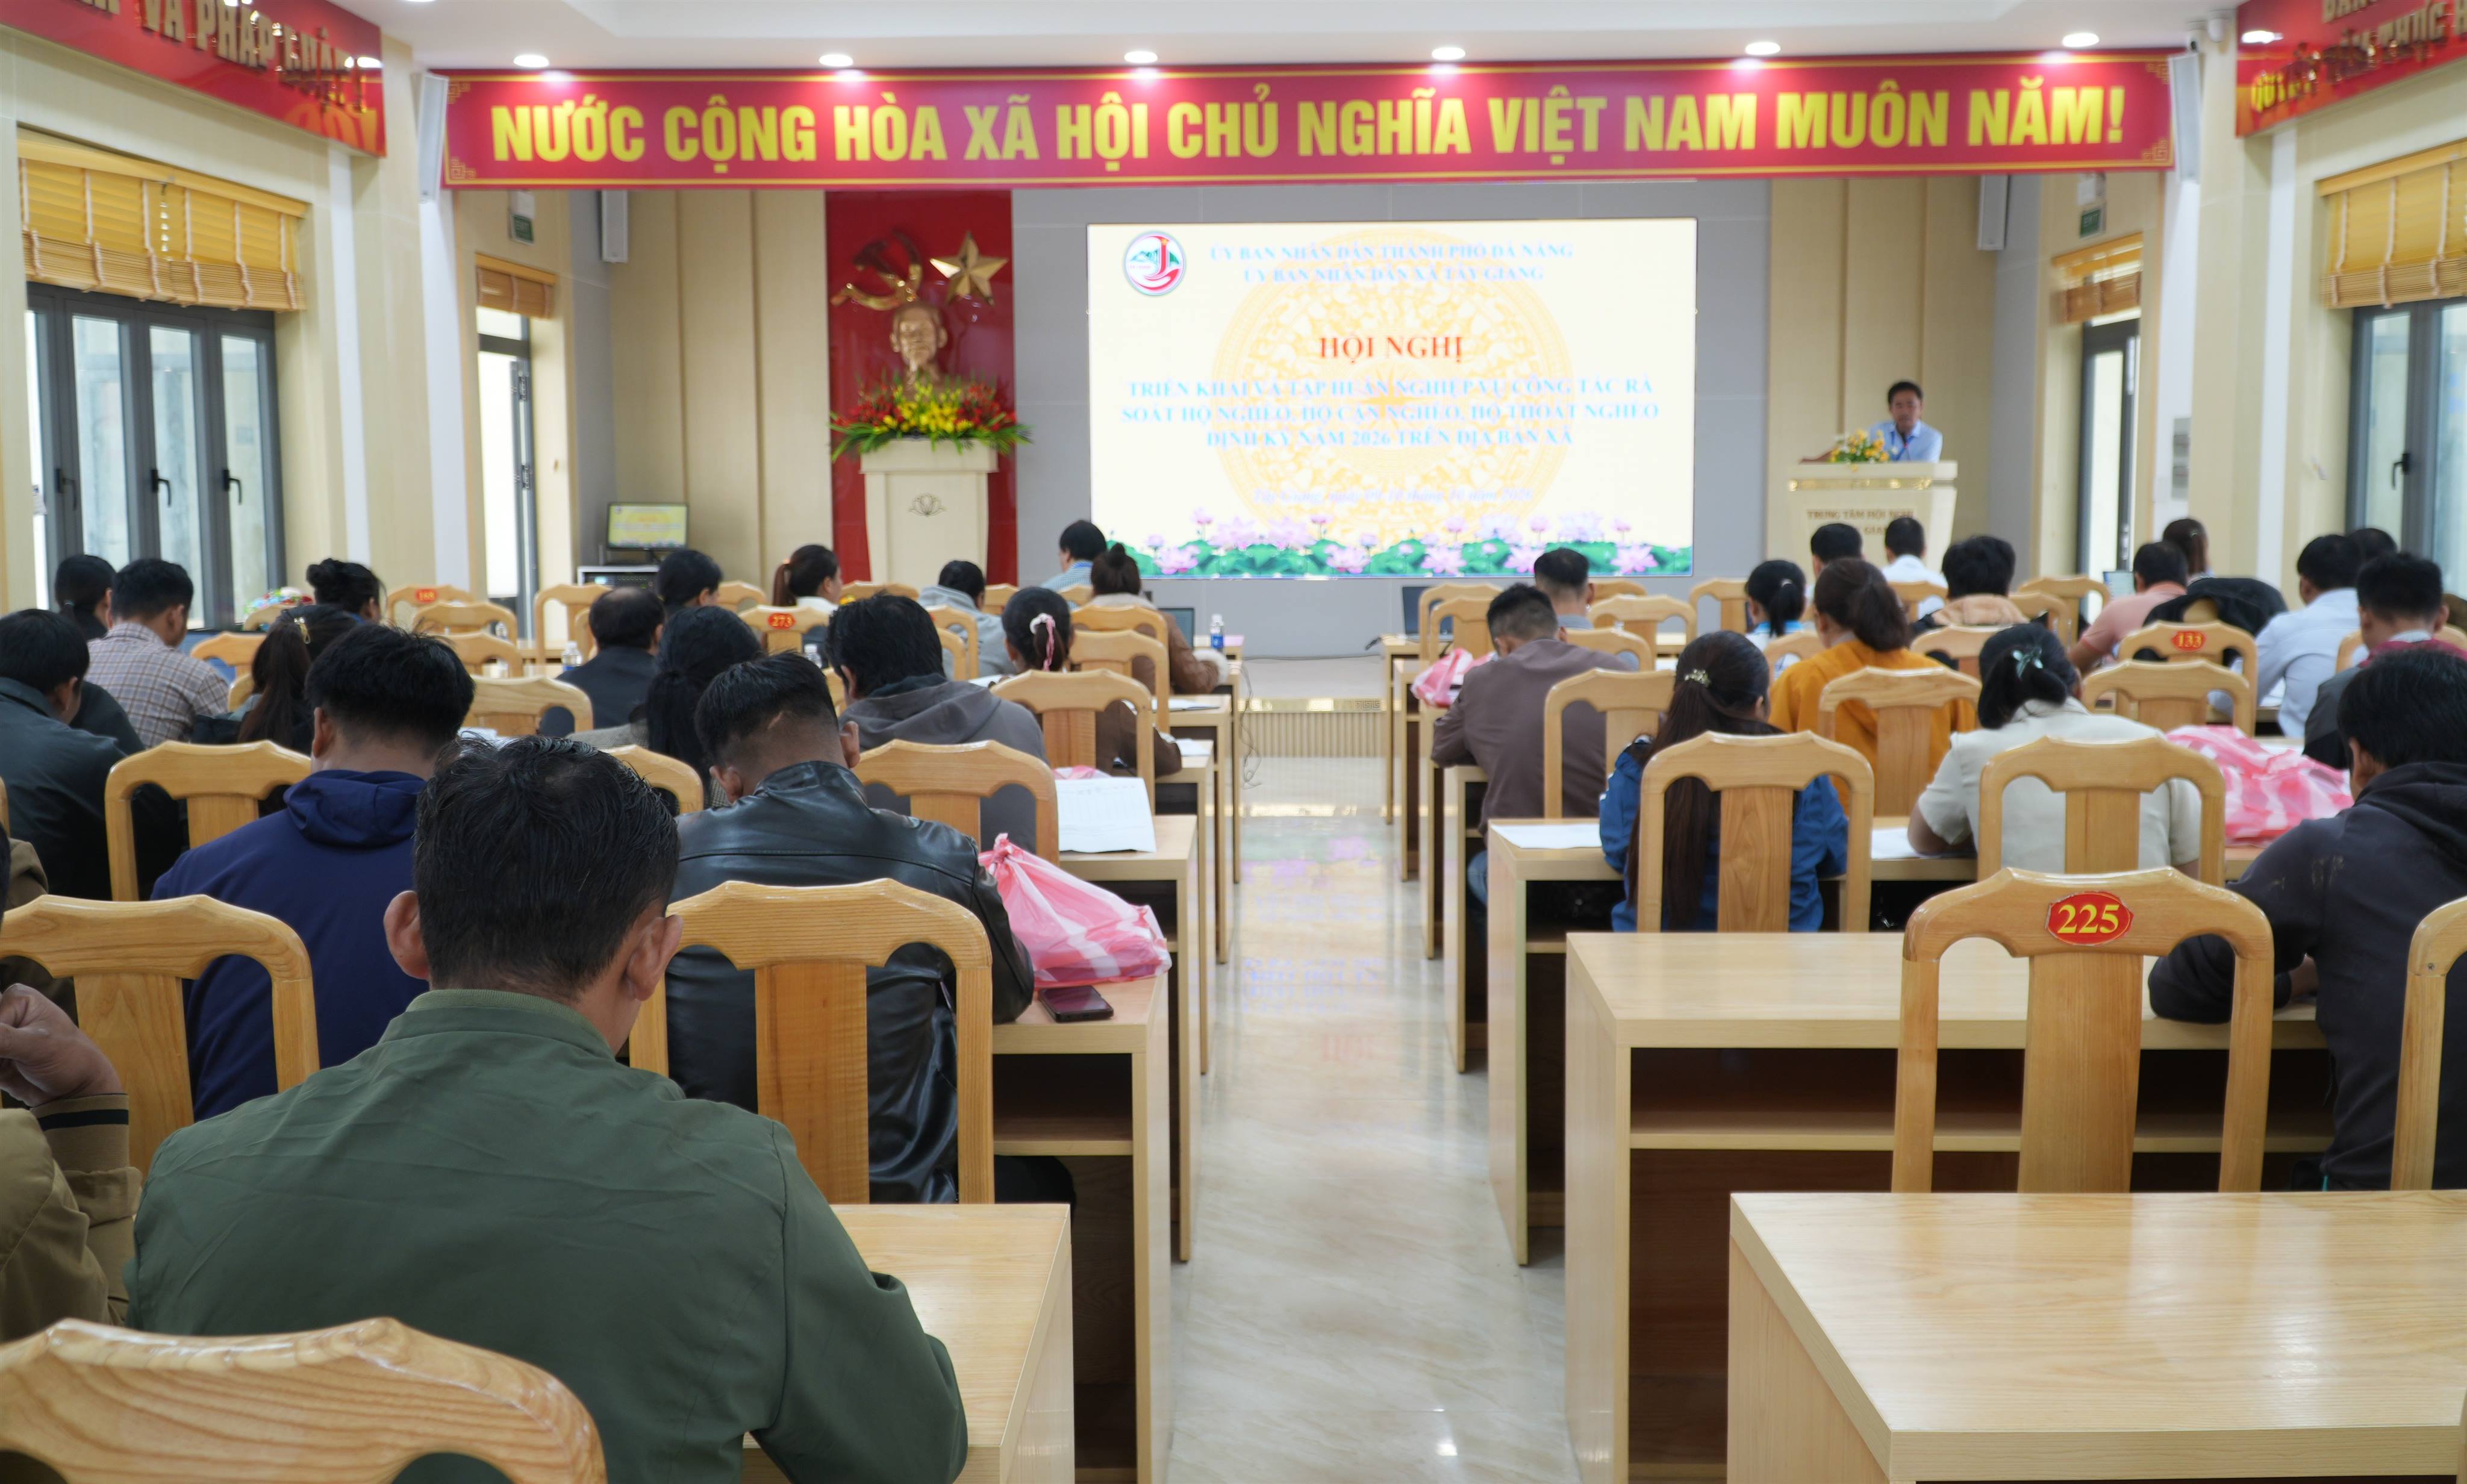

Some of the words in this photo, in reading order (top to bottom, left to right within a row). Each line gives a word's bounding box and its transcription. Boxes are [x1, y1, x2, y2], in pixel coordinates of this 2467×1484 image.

[491, 94, 644, 161] NƯỚC
[664, 94, 817, 173] CỘNG
[833, 92, 947, 161] HÒA
[965, 95, 1039, 160] XÃ
[1056, 92, 1149, 171] HỘI
[1167, 83, 1279, 158] CHỦ
[1299, 87, 1472, 155] NGHĨA
[1488, 86, 1607, 164] VIỆT
[1625, 93, 1758, 151] NAM
[1776, 79, 1948, 149] MUÔN
[1968, 76, 2125, 146] NĂM!
[1319, 333, 1374, 364] HỘI
[1386, 336, 1462, 363] NGHỊ
[772, 616, 793, 627] 273
[2177, 633, 2203, 647] 133
[2057, 904, 2120, 934] 225
